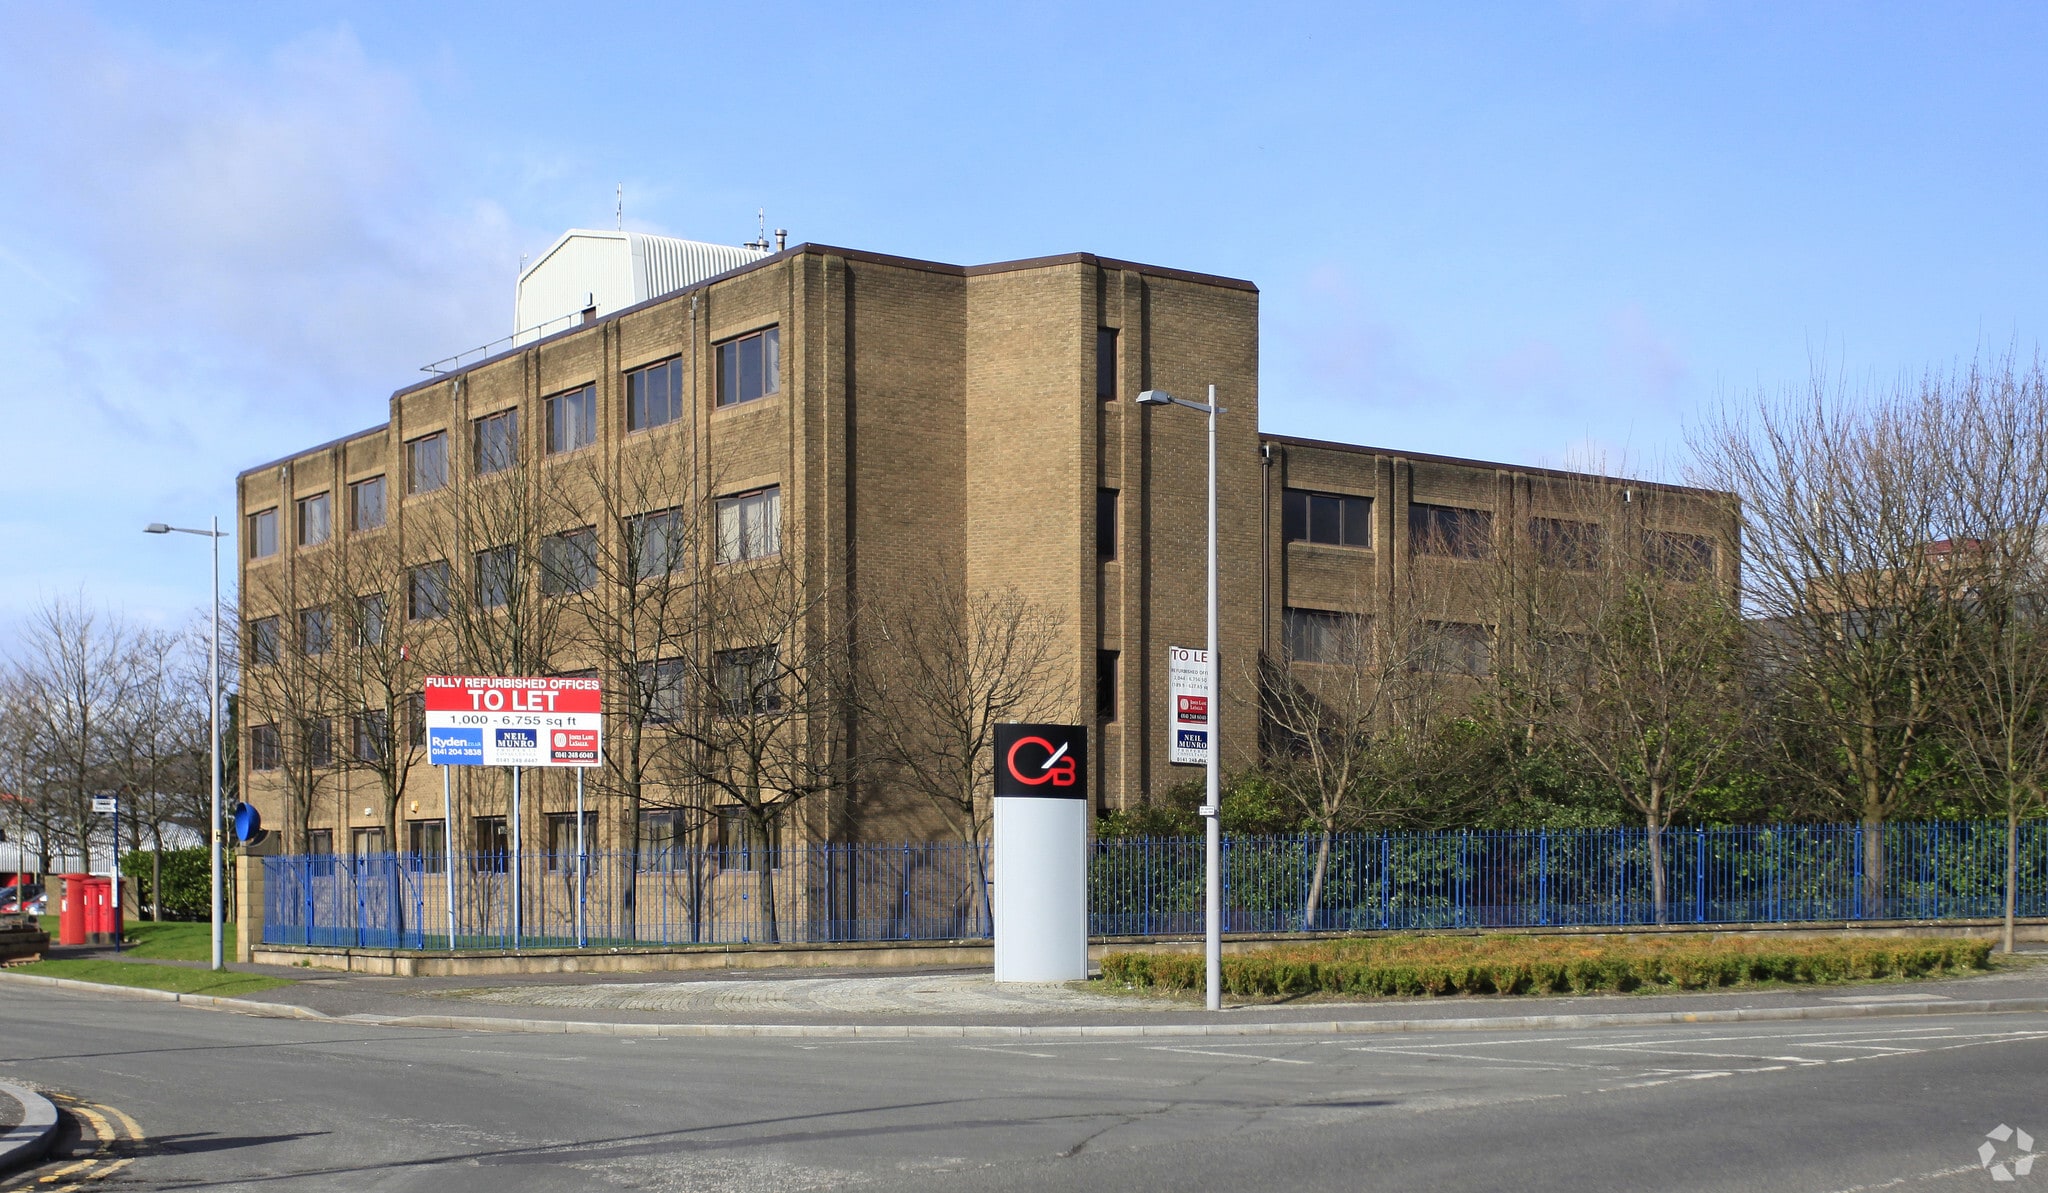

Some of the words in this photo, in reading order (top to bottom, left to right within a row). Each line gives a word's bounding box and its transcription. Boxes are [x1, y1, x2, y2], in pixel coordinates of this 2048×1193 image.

[1171, 649, 1188, 661] TO
[1194, 651, 1208, 662] LE
[426, 678, 462, 688] FULLY
[465, 678, 546, 689] REFURBISHED
[550, 680, 600, 690] OFFICES
[468, 690, 504, 711] TO
[512, 690, 559, 712] LET
[450, 715, 488, 724] 1,000
[502, 716, 541, 726] 6,755
[546, 718, 562, 727] sq
[568, 716, 576, 726] ft
[504, 732, 528, 740] NEIL
[497, 740, 535, 748] MUNRO
[1178, 740, 1207, 749] MUNRO
[432, 748, 447, 756] 0141
[448, 748, 462, 756] 204
